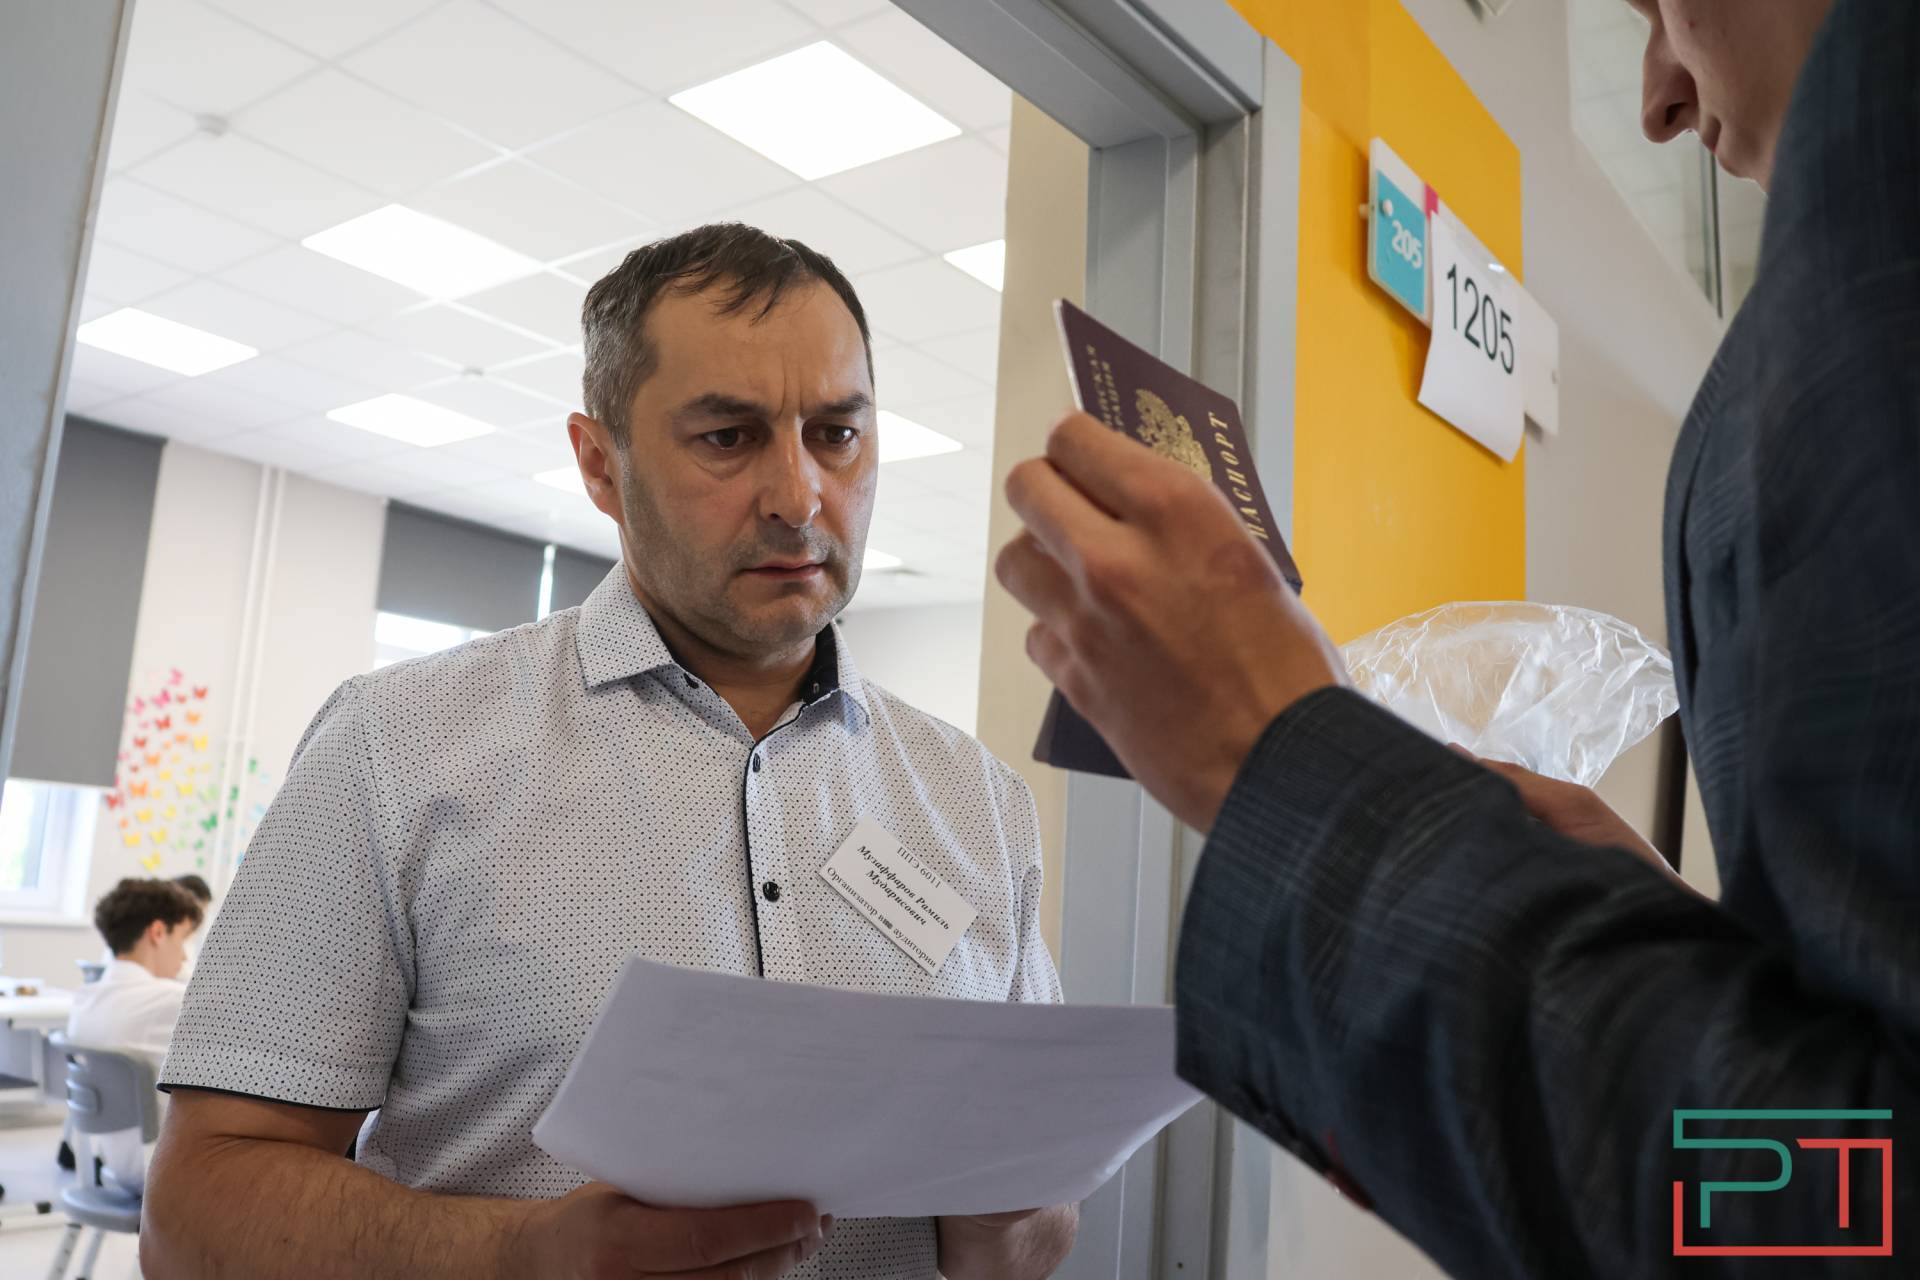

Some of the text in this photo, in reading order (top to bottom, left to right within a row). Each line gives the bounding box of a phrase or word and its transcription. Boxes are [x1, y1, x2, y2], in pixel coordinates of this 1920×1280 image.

[1392, 220, 1422, 268] 205
[1447, 263, 1514, 374] 1205
[1208, 412, 1269, 540] ПАСПОРТ
[857, 845, 950, 930] Музаффаров Рамиль
[866, 870, 927, 925] Мударисович
[897, 847, 941, 888] ППЭ 6011
[827, 867, 878, 916] Организатор
[893, 928, 936, 968] аудитории
